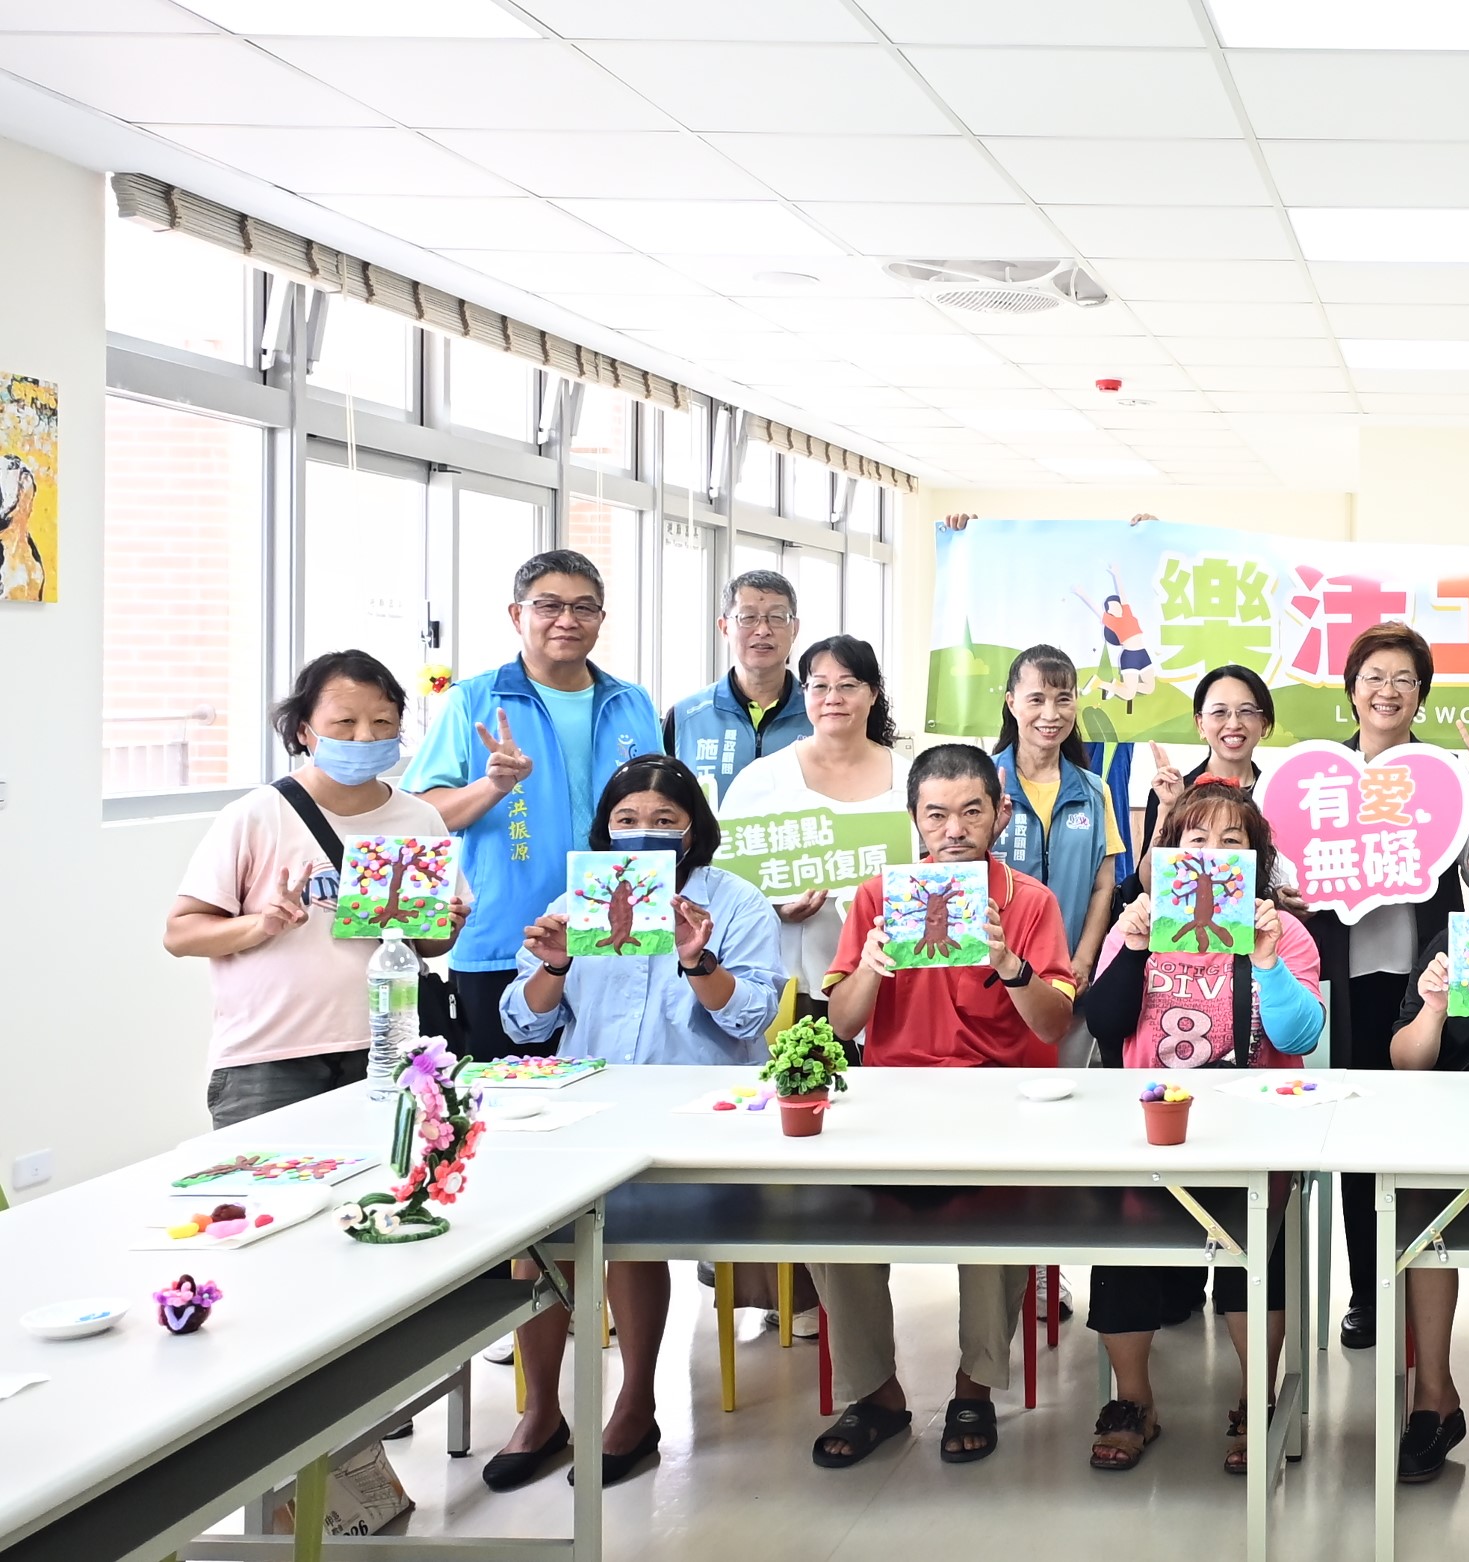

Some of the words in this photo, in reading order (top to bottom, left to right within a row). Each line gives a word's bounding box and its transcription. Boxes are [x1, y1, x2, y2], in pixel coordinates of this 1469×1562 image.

[1298, 767, 1414, 830] 有愛
[758, 843, 887, 891] 走向復原
[1303, 829, 1422, 895] 無礙
[1147, 969, 1234, 1000] DIV
[1157, 1006, 1213, 1069] 8
